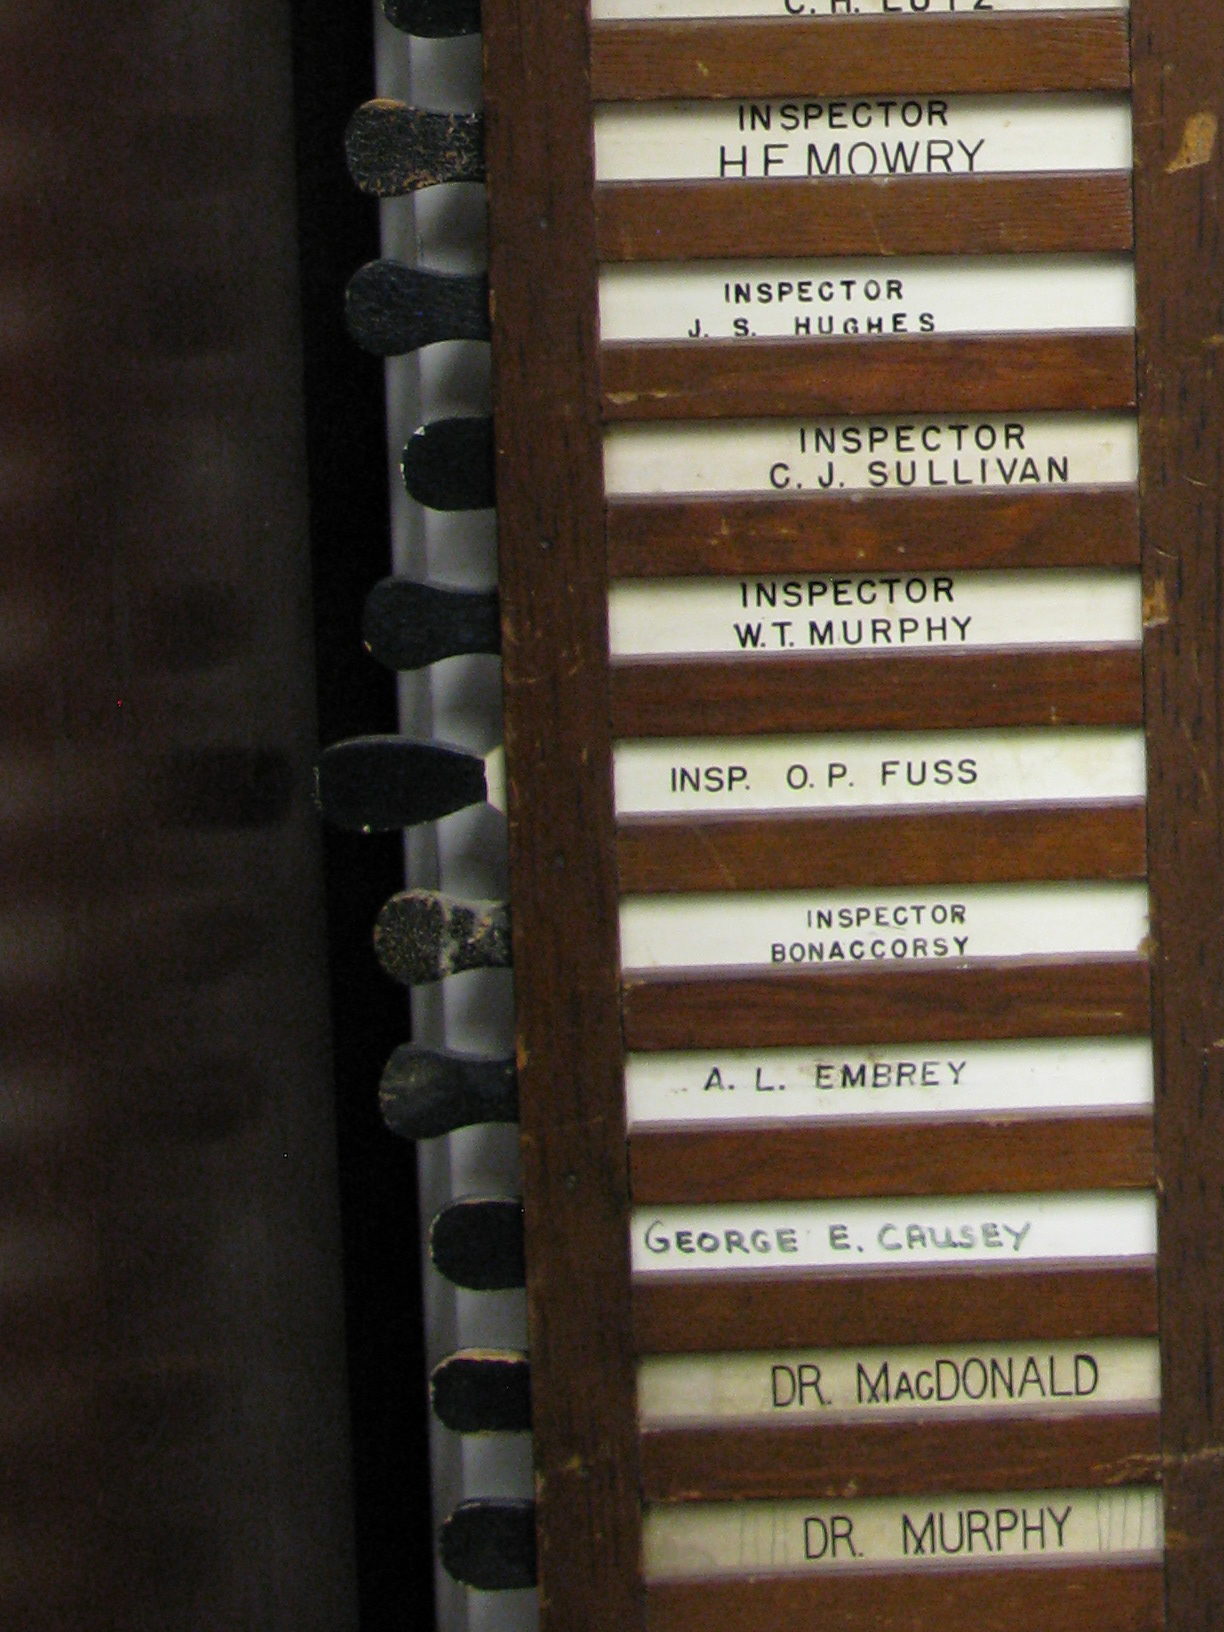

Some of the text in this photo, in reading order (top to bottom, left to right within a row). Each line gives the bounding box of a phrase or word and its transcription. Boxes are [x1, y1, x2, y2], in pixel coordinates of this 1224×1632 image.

[738, 102, 950, 131] INSPECTOR
[806, 138, 985, 176] MOWRY
[723, 279, 904, 304] INSPECTOR
[688, 313, 936, 339] J. S. HUGHES
[799, 423, 1026, 455] INSPECTOR
[868, 456, 1071, 487] SULLIVAN
[741, 577, 955, 608] INSPECTOR
[808, 616, 973, 646] MURPHY
[670, 767, 750, 792] INSP.
[881, 759, 979, 786] FUSS
[807, 904, 968, 929] INSPECTOR
[771, 936, 971, 962] BONACCORSY
[702, 1060, 967, 1092] A. L. EMBREY
[644, 1220, 799, 1254] GEORGE
[828, 1225, 865, 1253] E.
[771, 1365, 833, 1408] DR.
[803, 1506, 1072, 1559] DR. MURPHY
